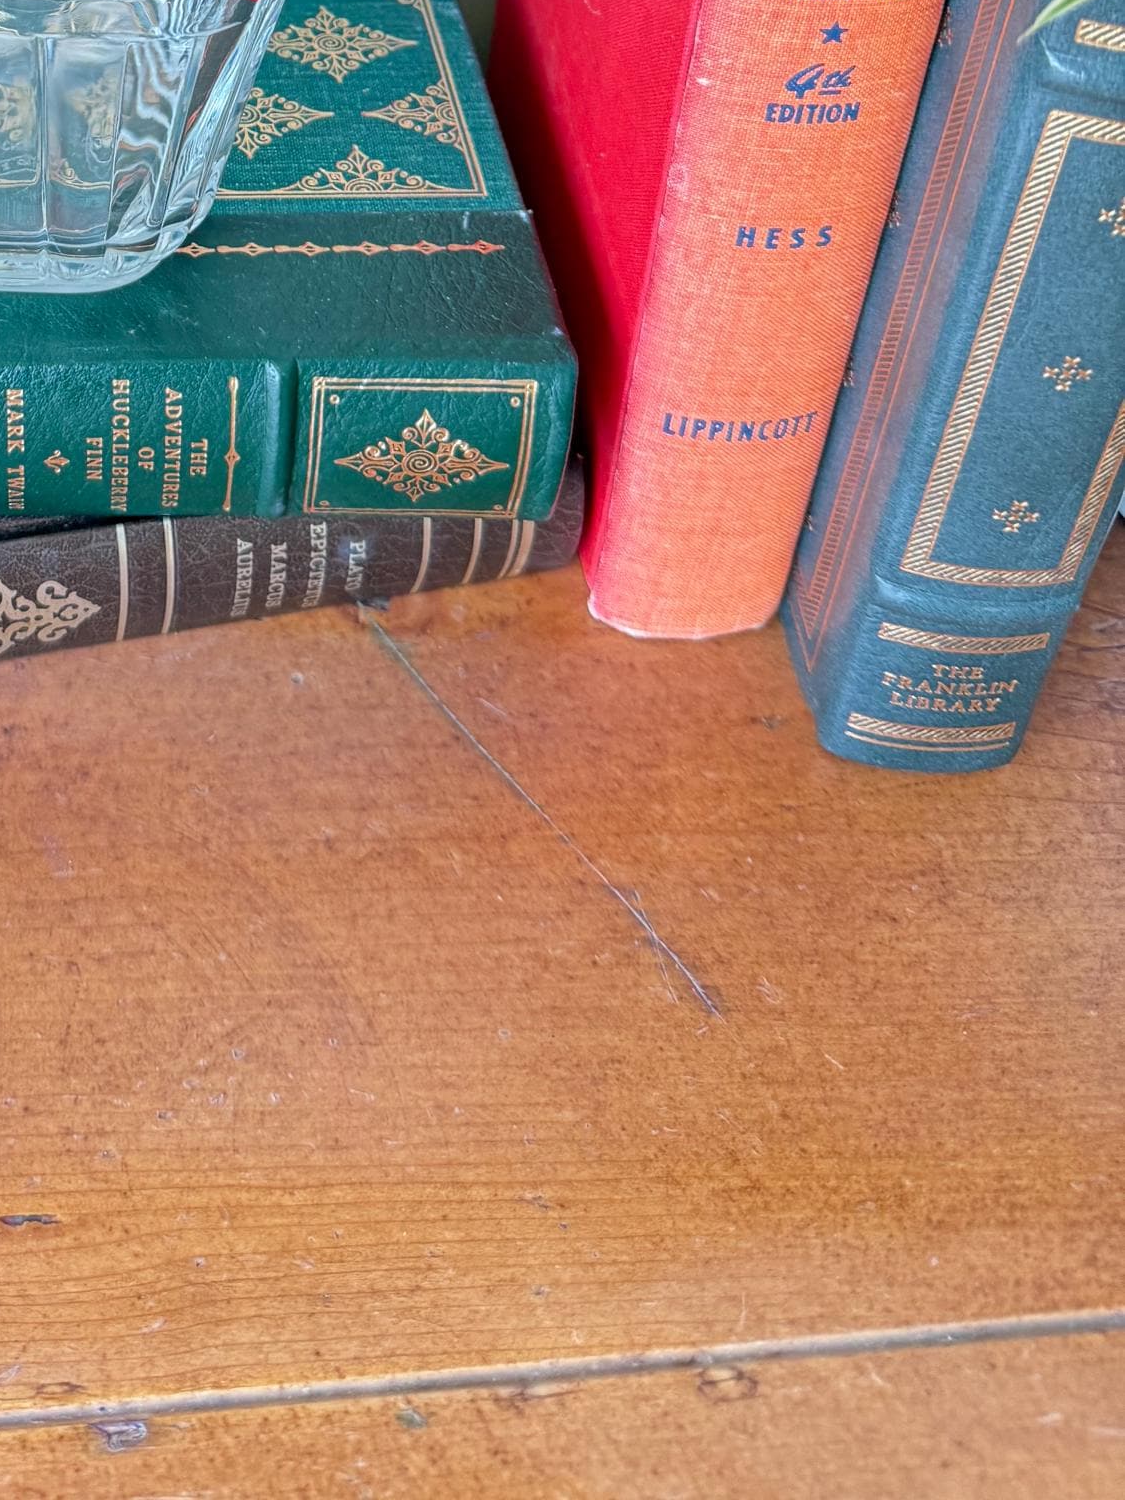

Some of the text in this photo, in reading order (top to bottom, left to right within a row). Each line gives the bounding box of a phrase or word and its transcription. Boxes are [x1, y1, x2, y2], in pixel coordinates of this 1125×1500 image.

[785, 63, 856, 99] 4th
[765, 102, 860, 124] EDITION
[735, 226, 833, 249] HESS
[110, 379, 130, 512] HUCKLEBERRY
[662, 411, 818, 441] LIPPINCOTT
[6, 389, 25, 510] MARK TWAIN
[86, 437, 103, 481] FINN
[138, 446, 155, 471] OF
[162, 387, 183, 508] ADVENTURES
[189, 438, 208, 477] THE
[230, 538, 253, 617] AURELIUS
[265, 542, 287, 609] MARCUS
[302, 522, 327, 609] EPICTETUS
[344, 540, 366, 591] PLATO
[880, 671, 1018, 696] FRANKLIN
[932, 664, 985, 680] THE
[890, 691, 1002, 714] LIBRARY
